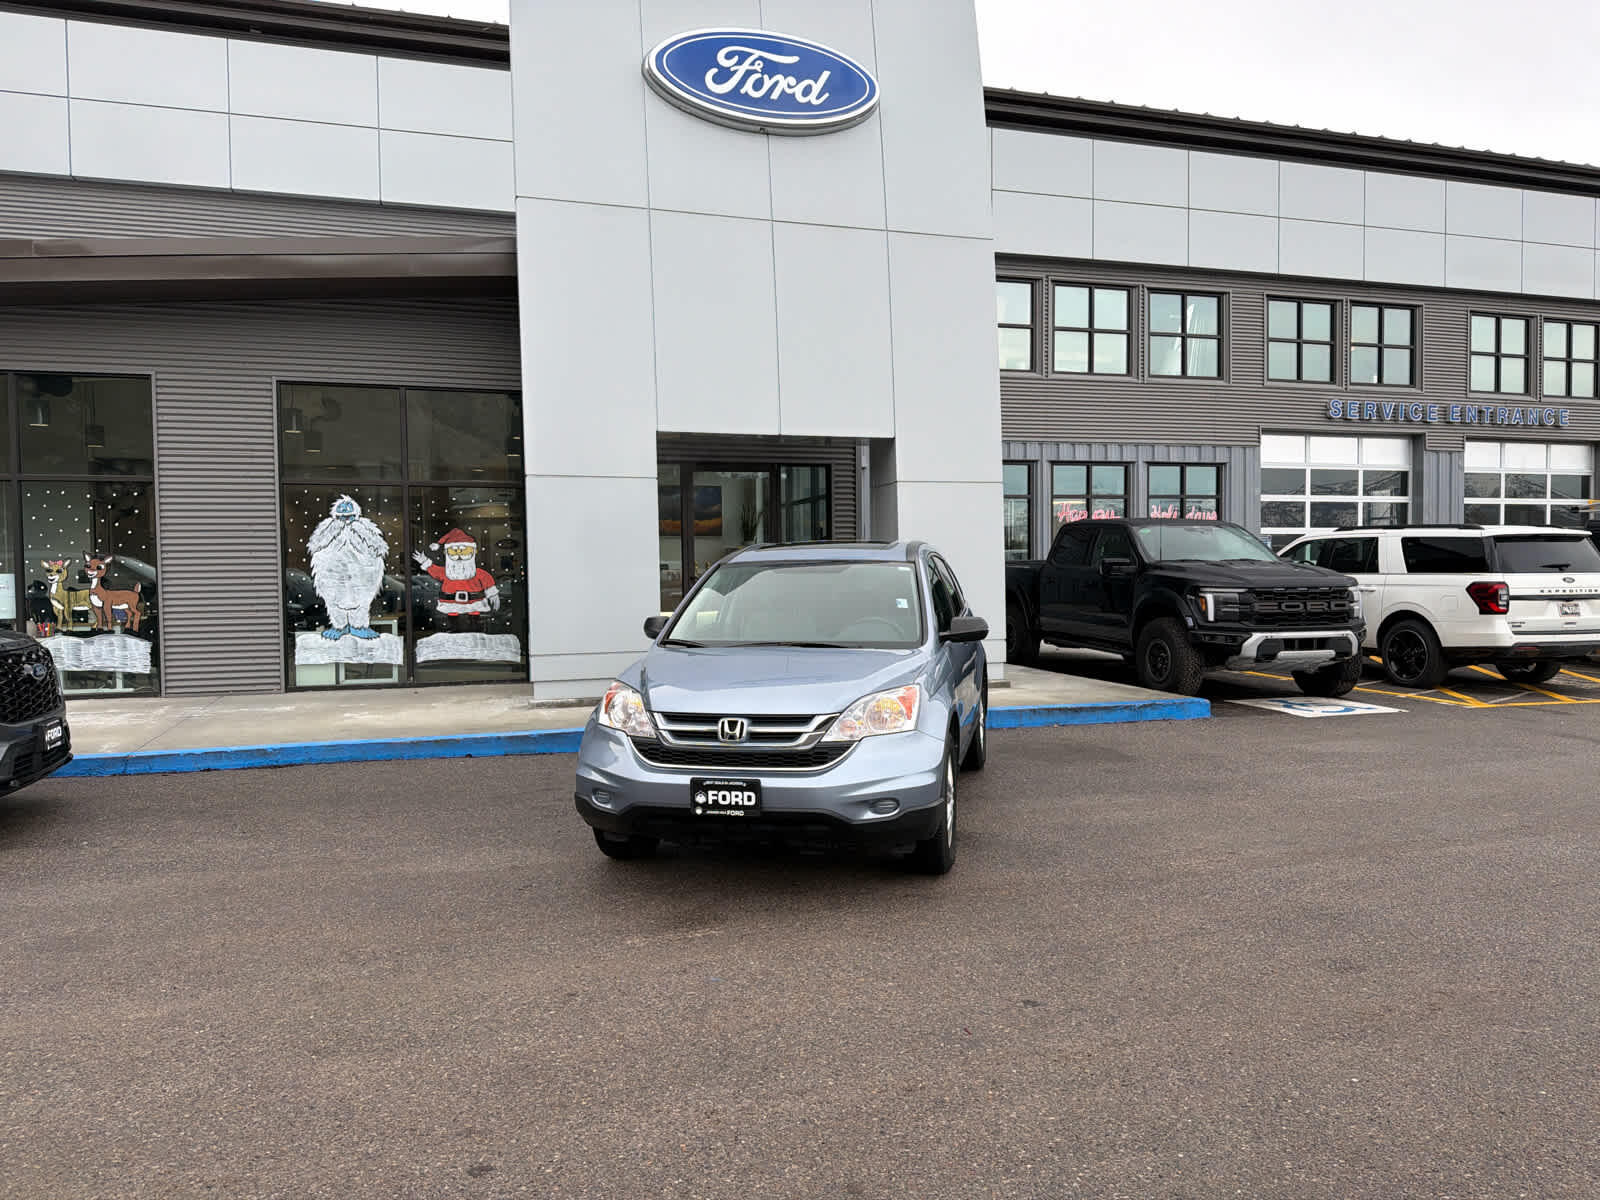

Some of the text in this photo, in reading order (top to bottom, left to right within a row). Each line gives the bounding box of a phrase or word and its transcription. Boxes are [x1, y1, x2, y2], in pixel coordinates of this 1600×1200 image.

[704, 45, 831, 105] Ford
[1329, 399, 1569, 425] SERVICE ENTRANCE
[1254, 600, 1349, 614] FORD
[47, 726, 61, 741] FORD
[707, 790, 756, 806] FORD
